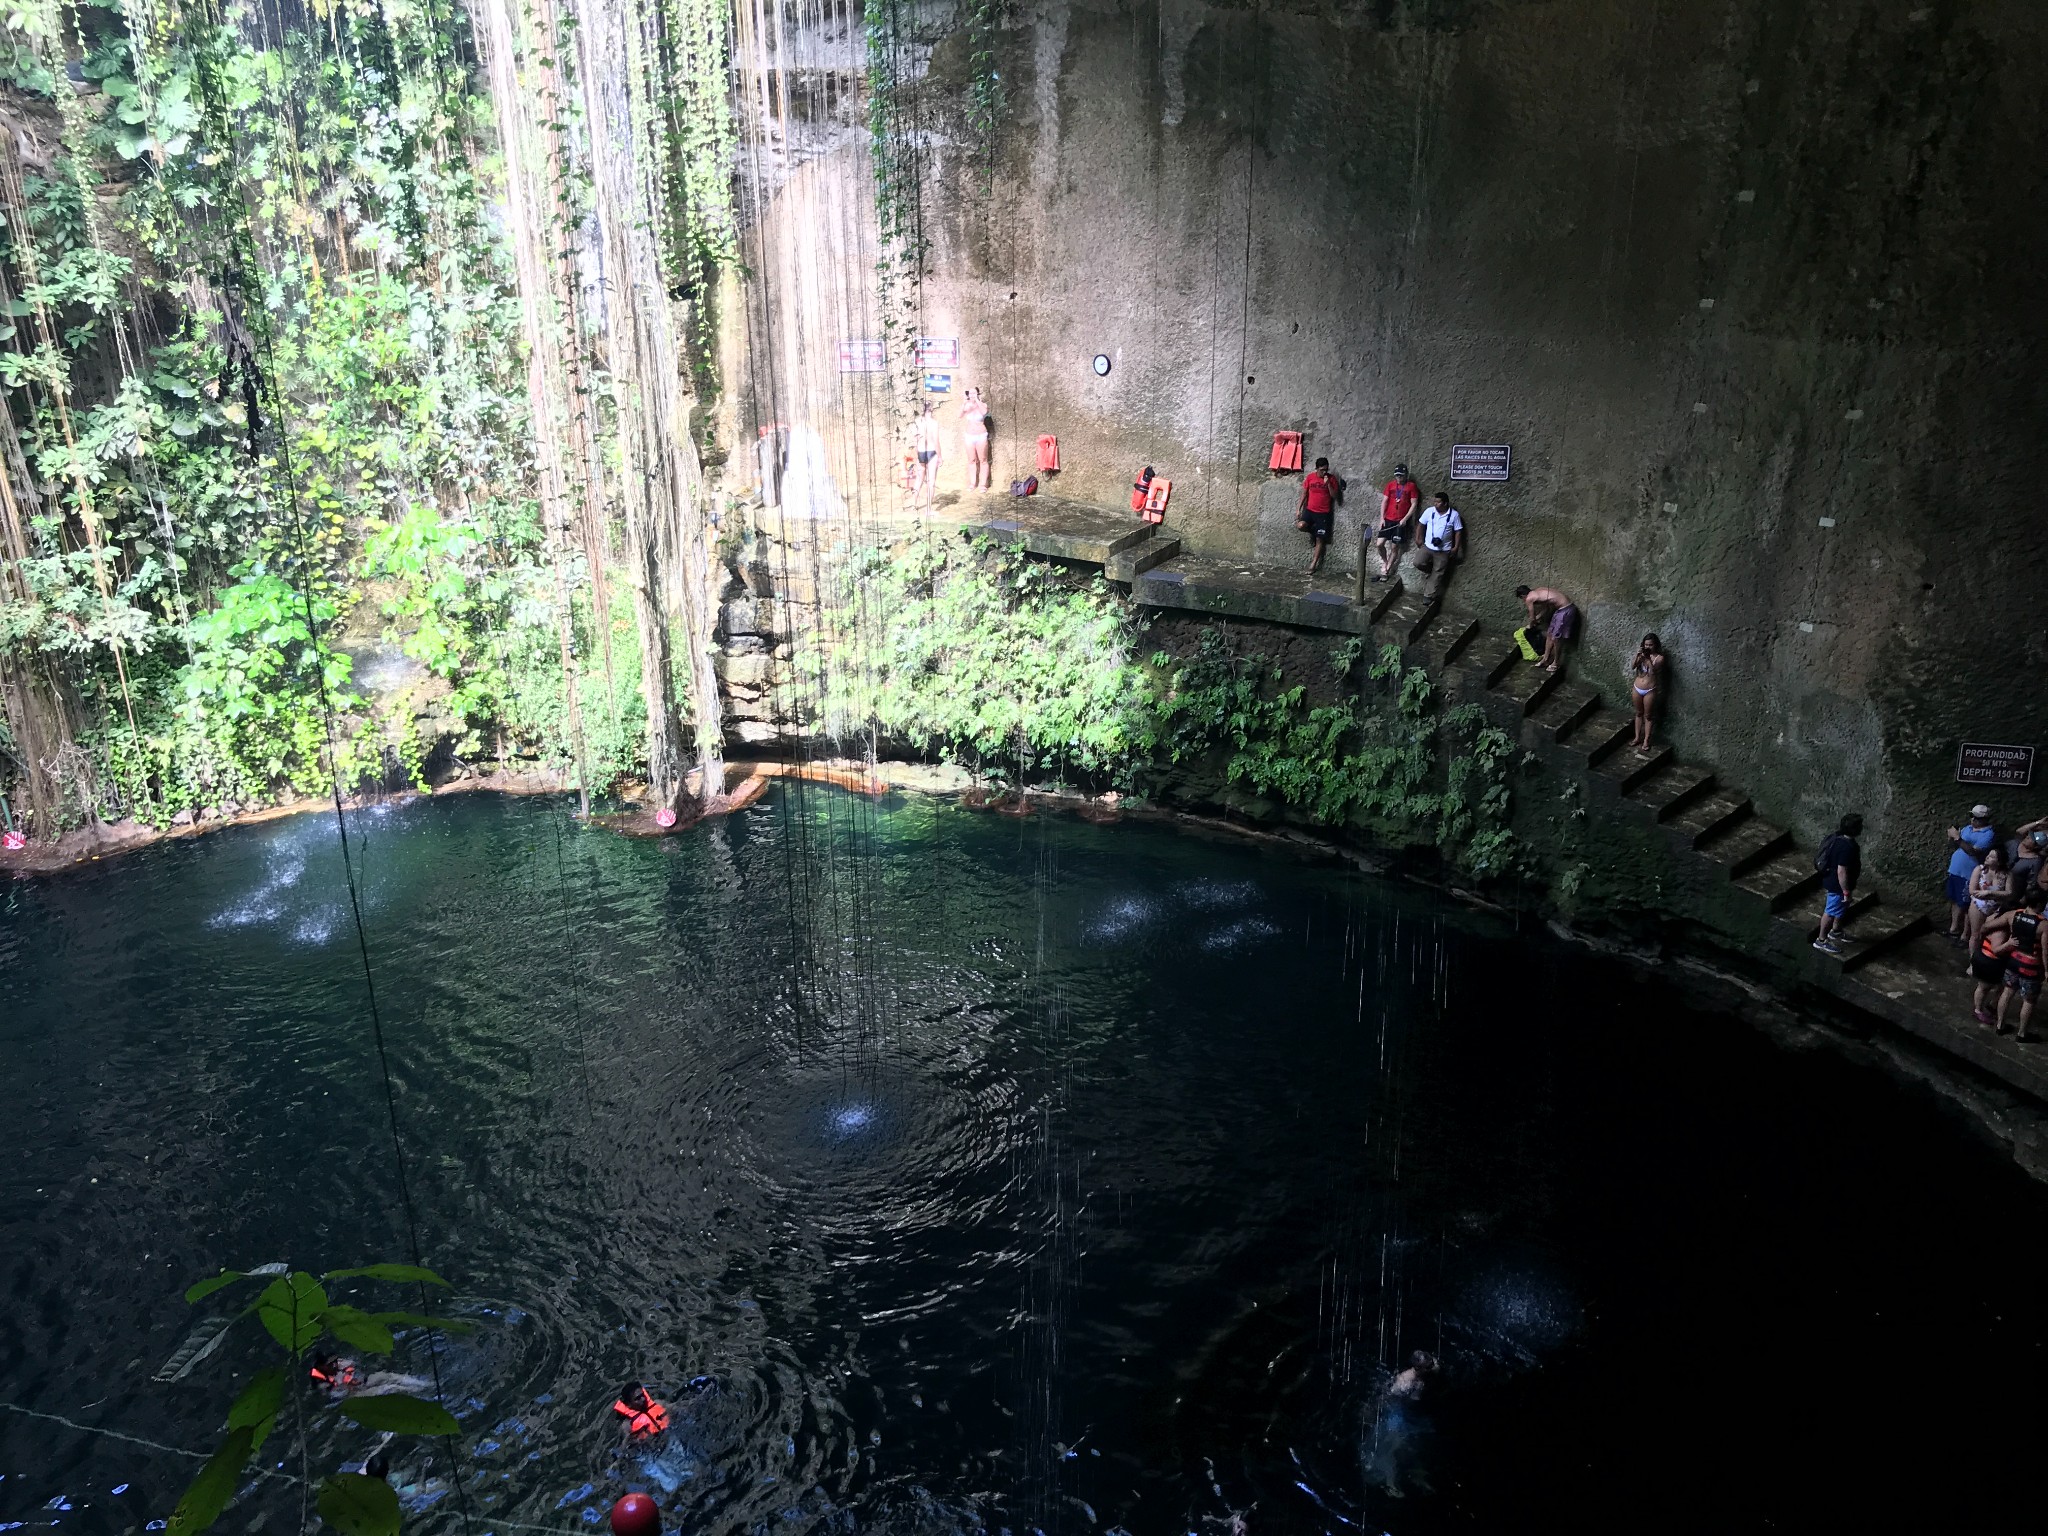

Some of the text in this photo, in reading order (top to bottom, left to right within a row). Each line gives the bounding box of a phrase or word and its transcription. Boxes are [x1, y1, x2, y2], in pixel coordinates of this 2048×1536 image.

[1965, 749, 2029, 760] PROFUNDIDAD:
[1963, 768, 2025, 779] DEPTH: 150 FT
